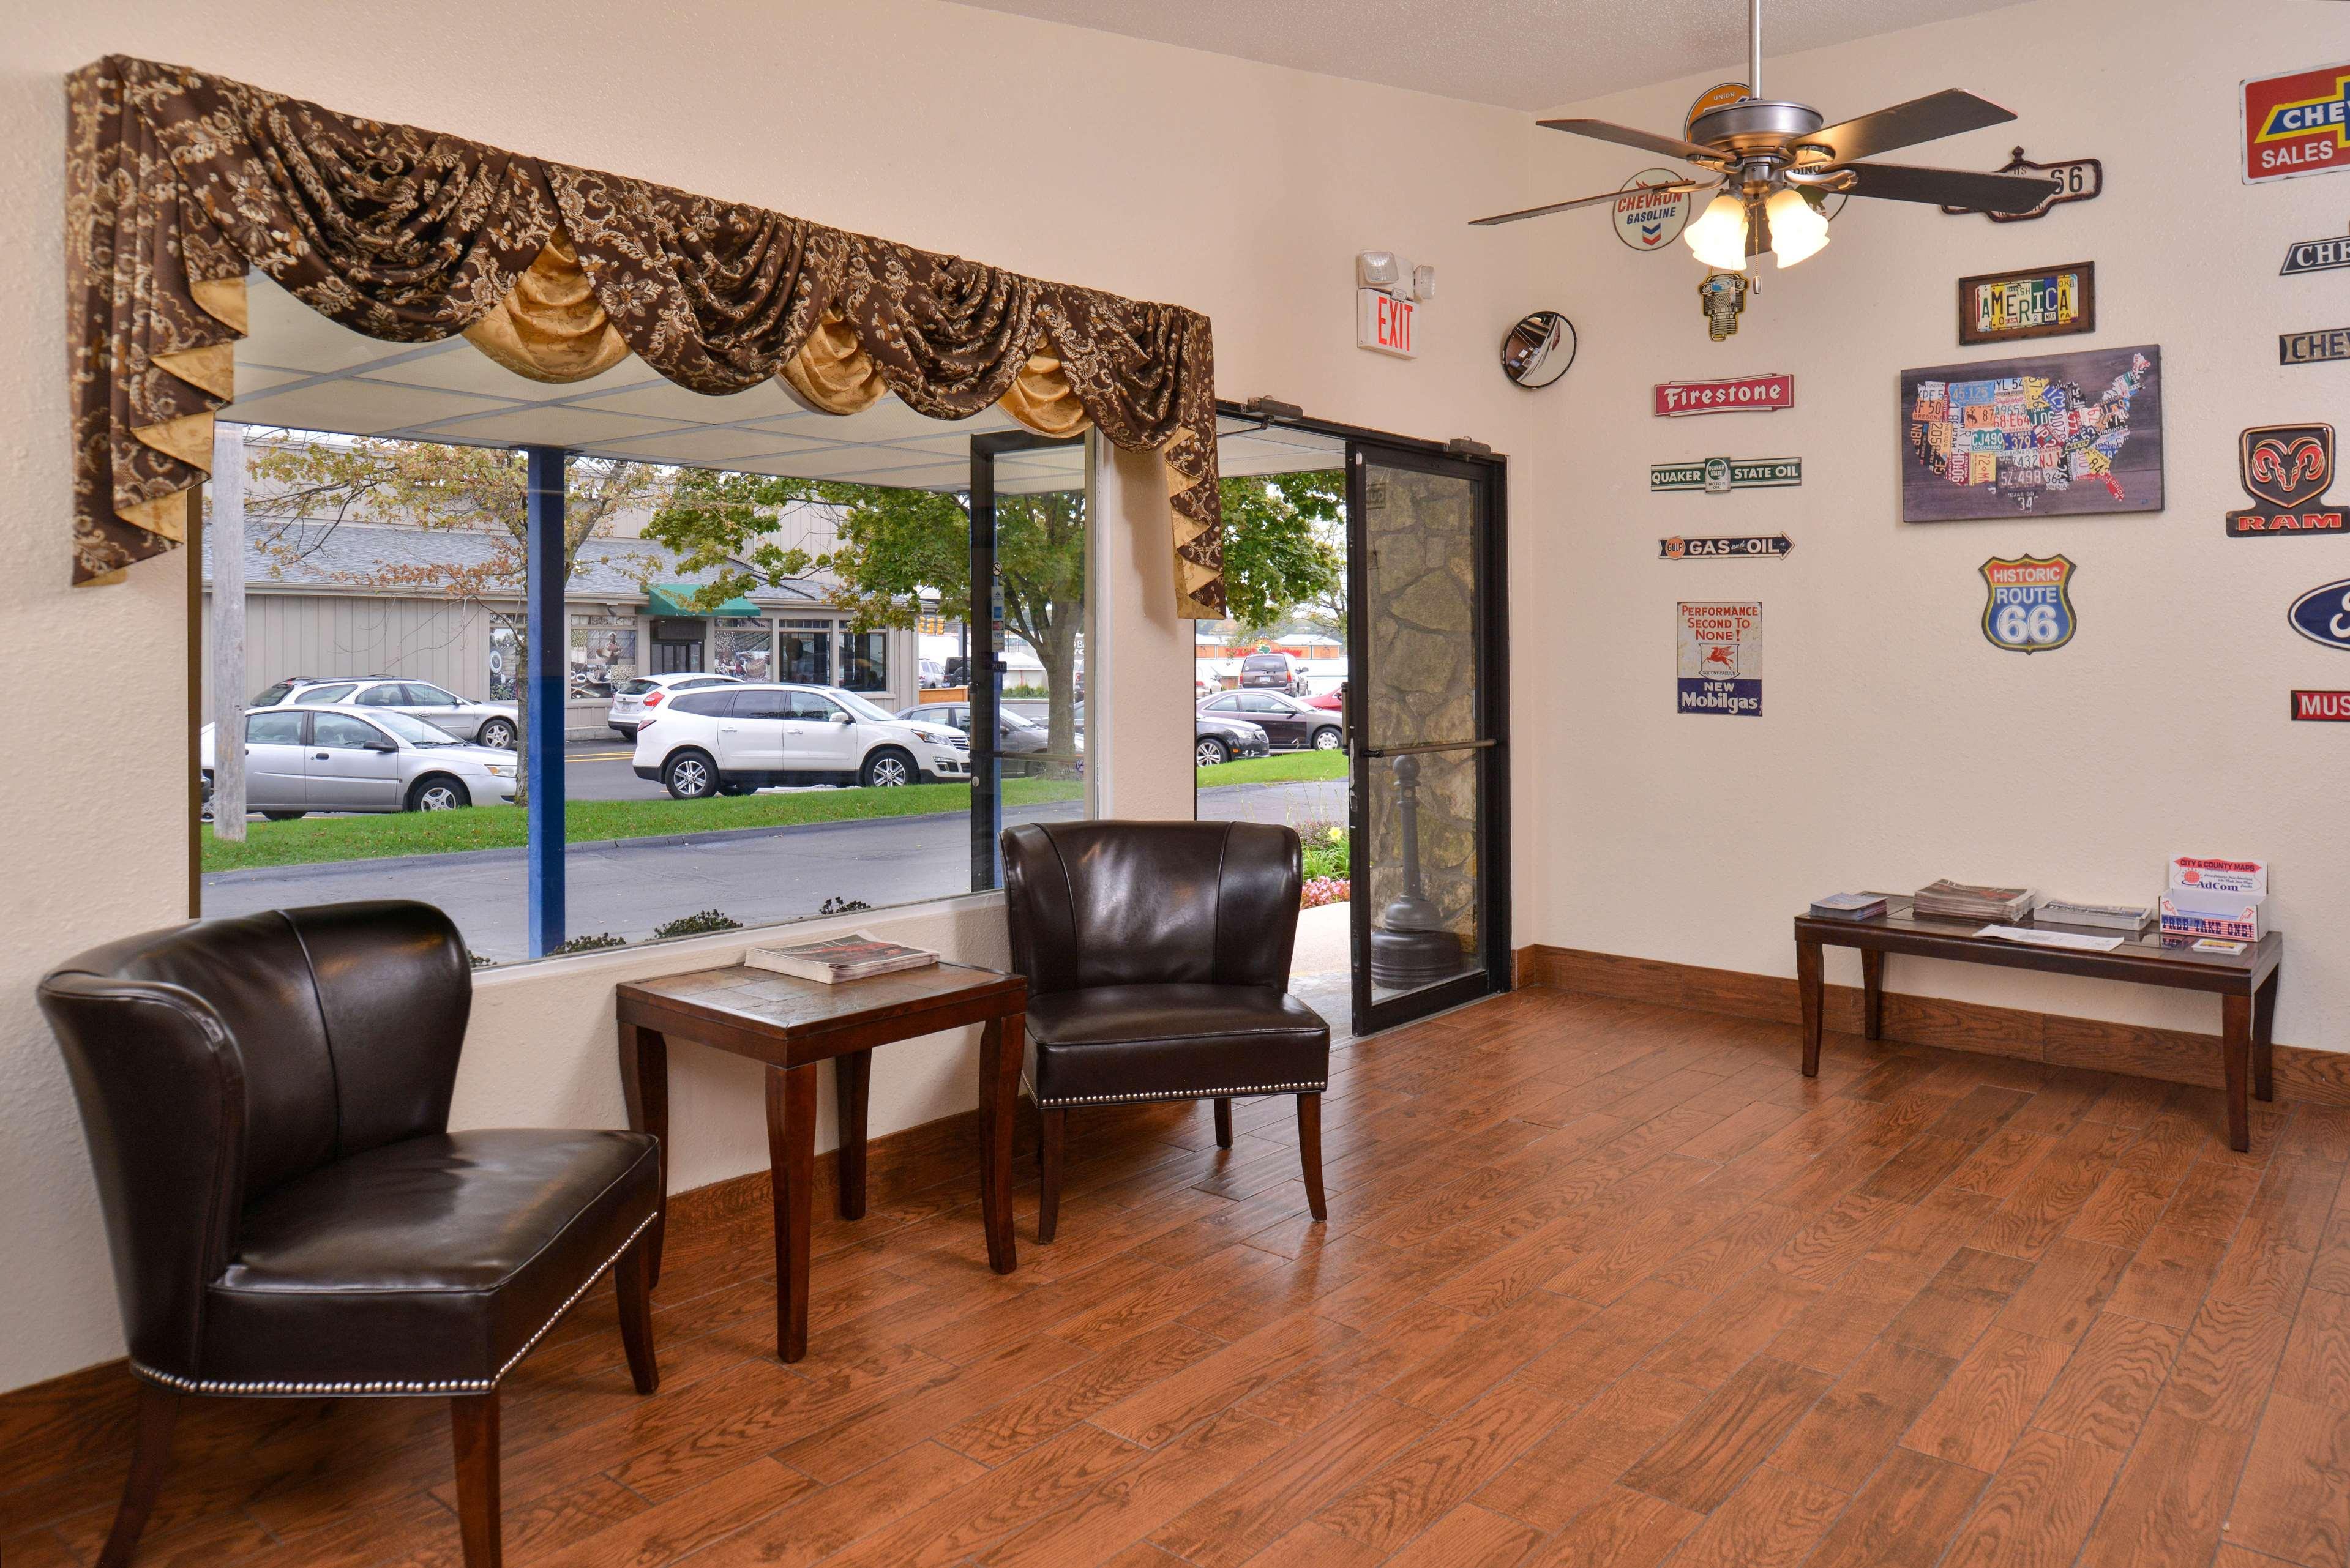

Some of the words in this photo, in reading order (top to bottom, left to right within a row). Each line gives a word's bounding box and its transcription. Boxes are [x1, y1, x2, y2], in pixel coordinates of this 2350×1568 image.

[1713, 92, 1735, 101] UNION
[2262, 140, 2334, 169] SALES
[2050, 166, 2084, 195] 66
[1617, 192, 1683, 213] CHEVRON
[1626, 206, 1676, 225] GASOLINE
[1981, 287, 2069, 324] AMERICA
[1378, 296, 1413, 353] EXIT
[1996, 379, 2008, 391] YL
[1664, 384, 1781, 409] Firestone
[2098, 425, 2124, 436] VIRGINIA
[1972, 432, 2004, 447] CJ490
[1652, 471, 1701, 484] QUAKER
[1734, 468, 1772, 479] STATE
[1775, 466, 1798, 477] OIL
[2237, 513, 2341, 531] RAM
[1667, 542, 1683, 551] GULF
[1690, 540, 1730, 554] GAS
[1731, 541, 1745, 550] and
[1747, 539, 1780, 553] OIL
[1994, 567, 2060, 583] HISTORIC
[1997, 587, 2057, 604] ROUTE
[1682, 605, 1758, 616] PERFORMANCE
[1687, 617, 1732, 629] SECOND
[1735, 617, 1751, 629] TO
[1997, 605, 2059, 644] 66
[1704, 682, 1735, 692] NEW
[1682, 692, 1758, 714] Mobilgas
[2204, 861, 2232, 870] COUNTY
[2197, 881, 2239, 892] AdCom
[2163, 916, 2189, 931] FREE
[2195, 919, 2221, 935] TAKE
[2228, 923, 2253, 938] ONE!
